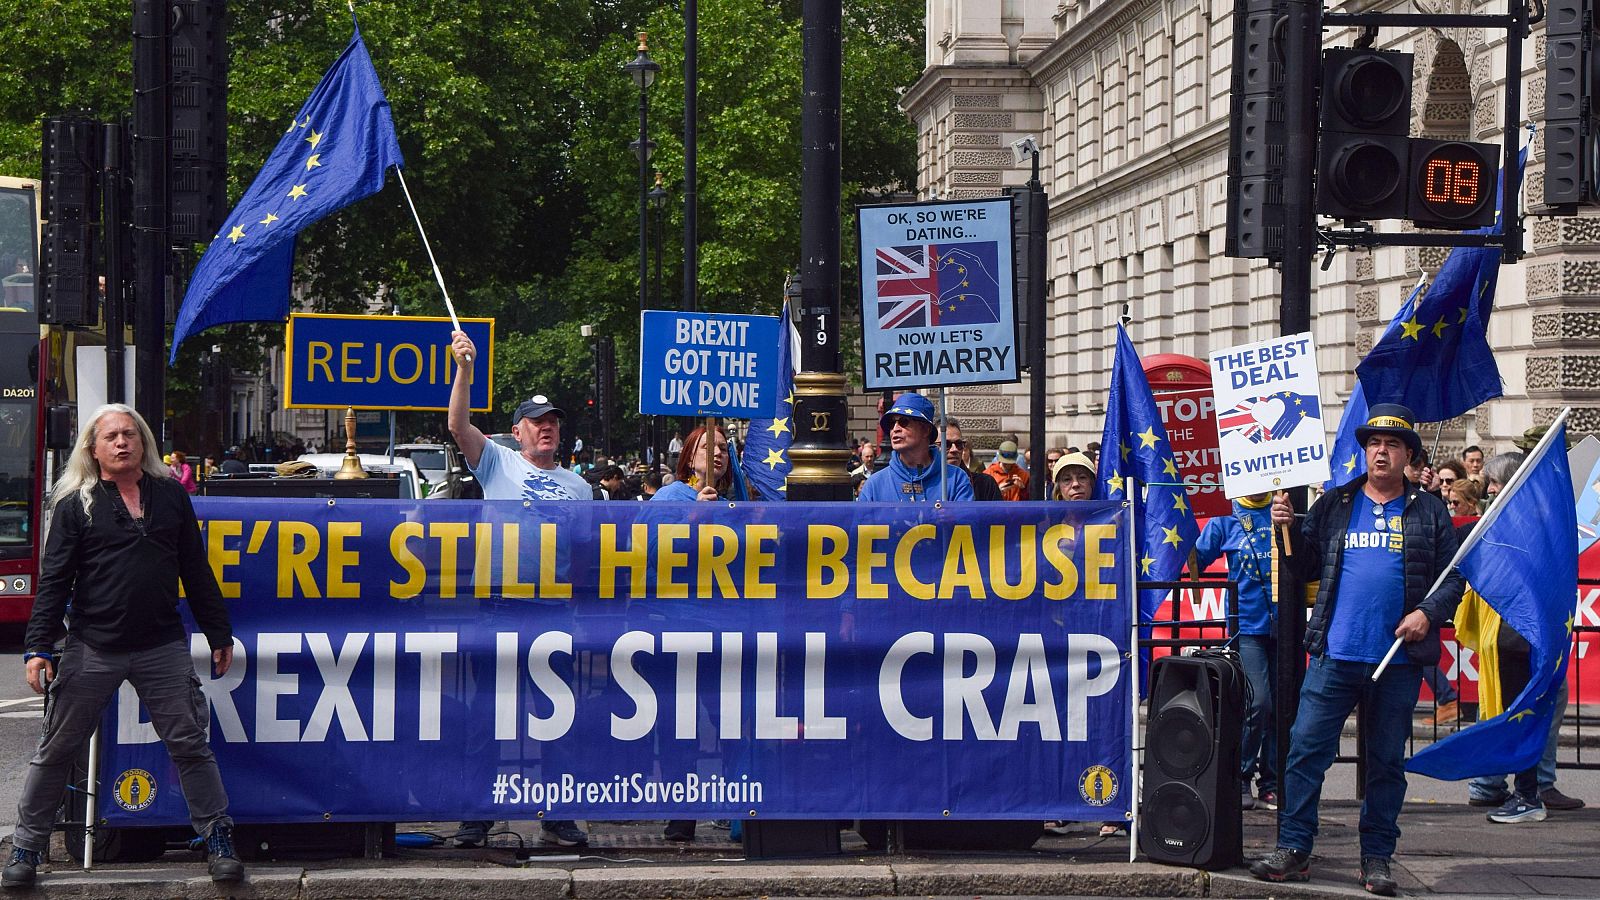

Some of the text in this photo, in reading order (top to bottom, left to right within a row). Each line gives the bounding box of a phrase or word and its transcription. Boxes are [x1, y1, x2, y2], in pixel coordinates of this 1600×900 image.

[1426, 159, 1479, 204] 08
[887, 208, 987, 226] OK, SO WE'RE
[906, 226, 977, 241] DATING...
[675, 318, 750, 347] BREXIT
[898, 329, 983, 346] NOW LET'S
[664, 349, 758, 378] GOT THE
[875, 345, 1011, 379] REMARRY
[1214, 338, 1309, 372] THE BEST
[1230, 360, 1299, 390] DEAL
[3, 388, 35, 398] DA201
[660, 379, 760, 409] UK DONE
[1155, 396, 1216, 424] TOP
[1173, 447, 1221, 469] EXIT
[1224, 461, 1241, 477] IS
[1244, 451, 1294, 474] WITH
[1297, 443, 1324, 464] EU
[178, 520, 1117, 601] E'RE STILL HERE BECAUSE
[494, 630, 576, 742] IS
[609, 630, 847, 742] STILL
[878, 631, 1121, 742] CRAP
[492, 773, 763, 811] #StopBrexitSaveBritain
